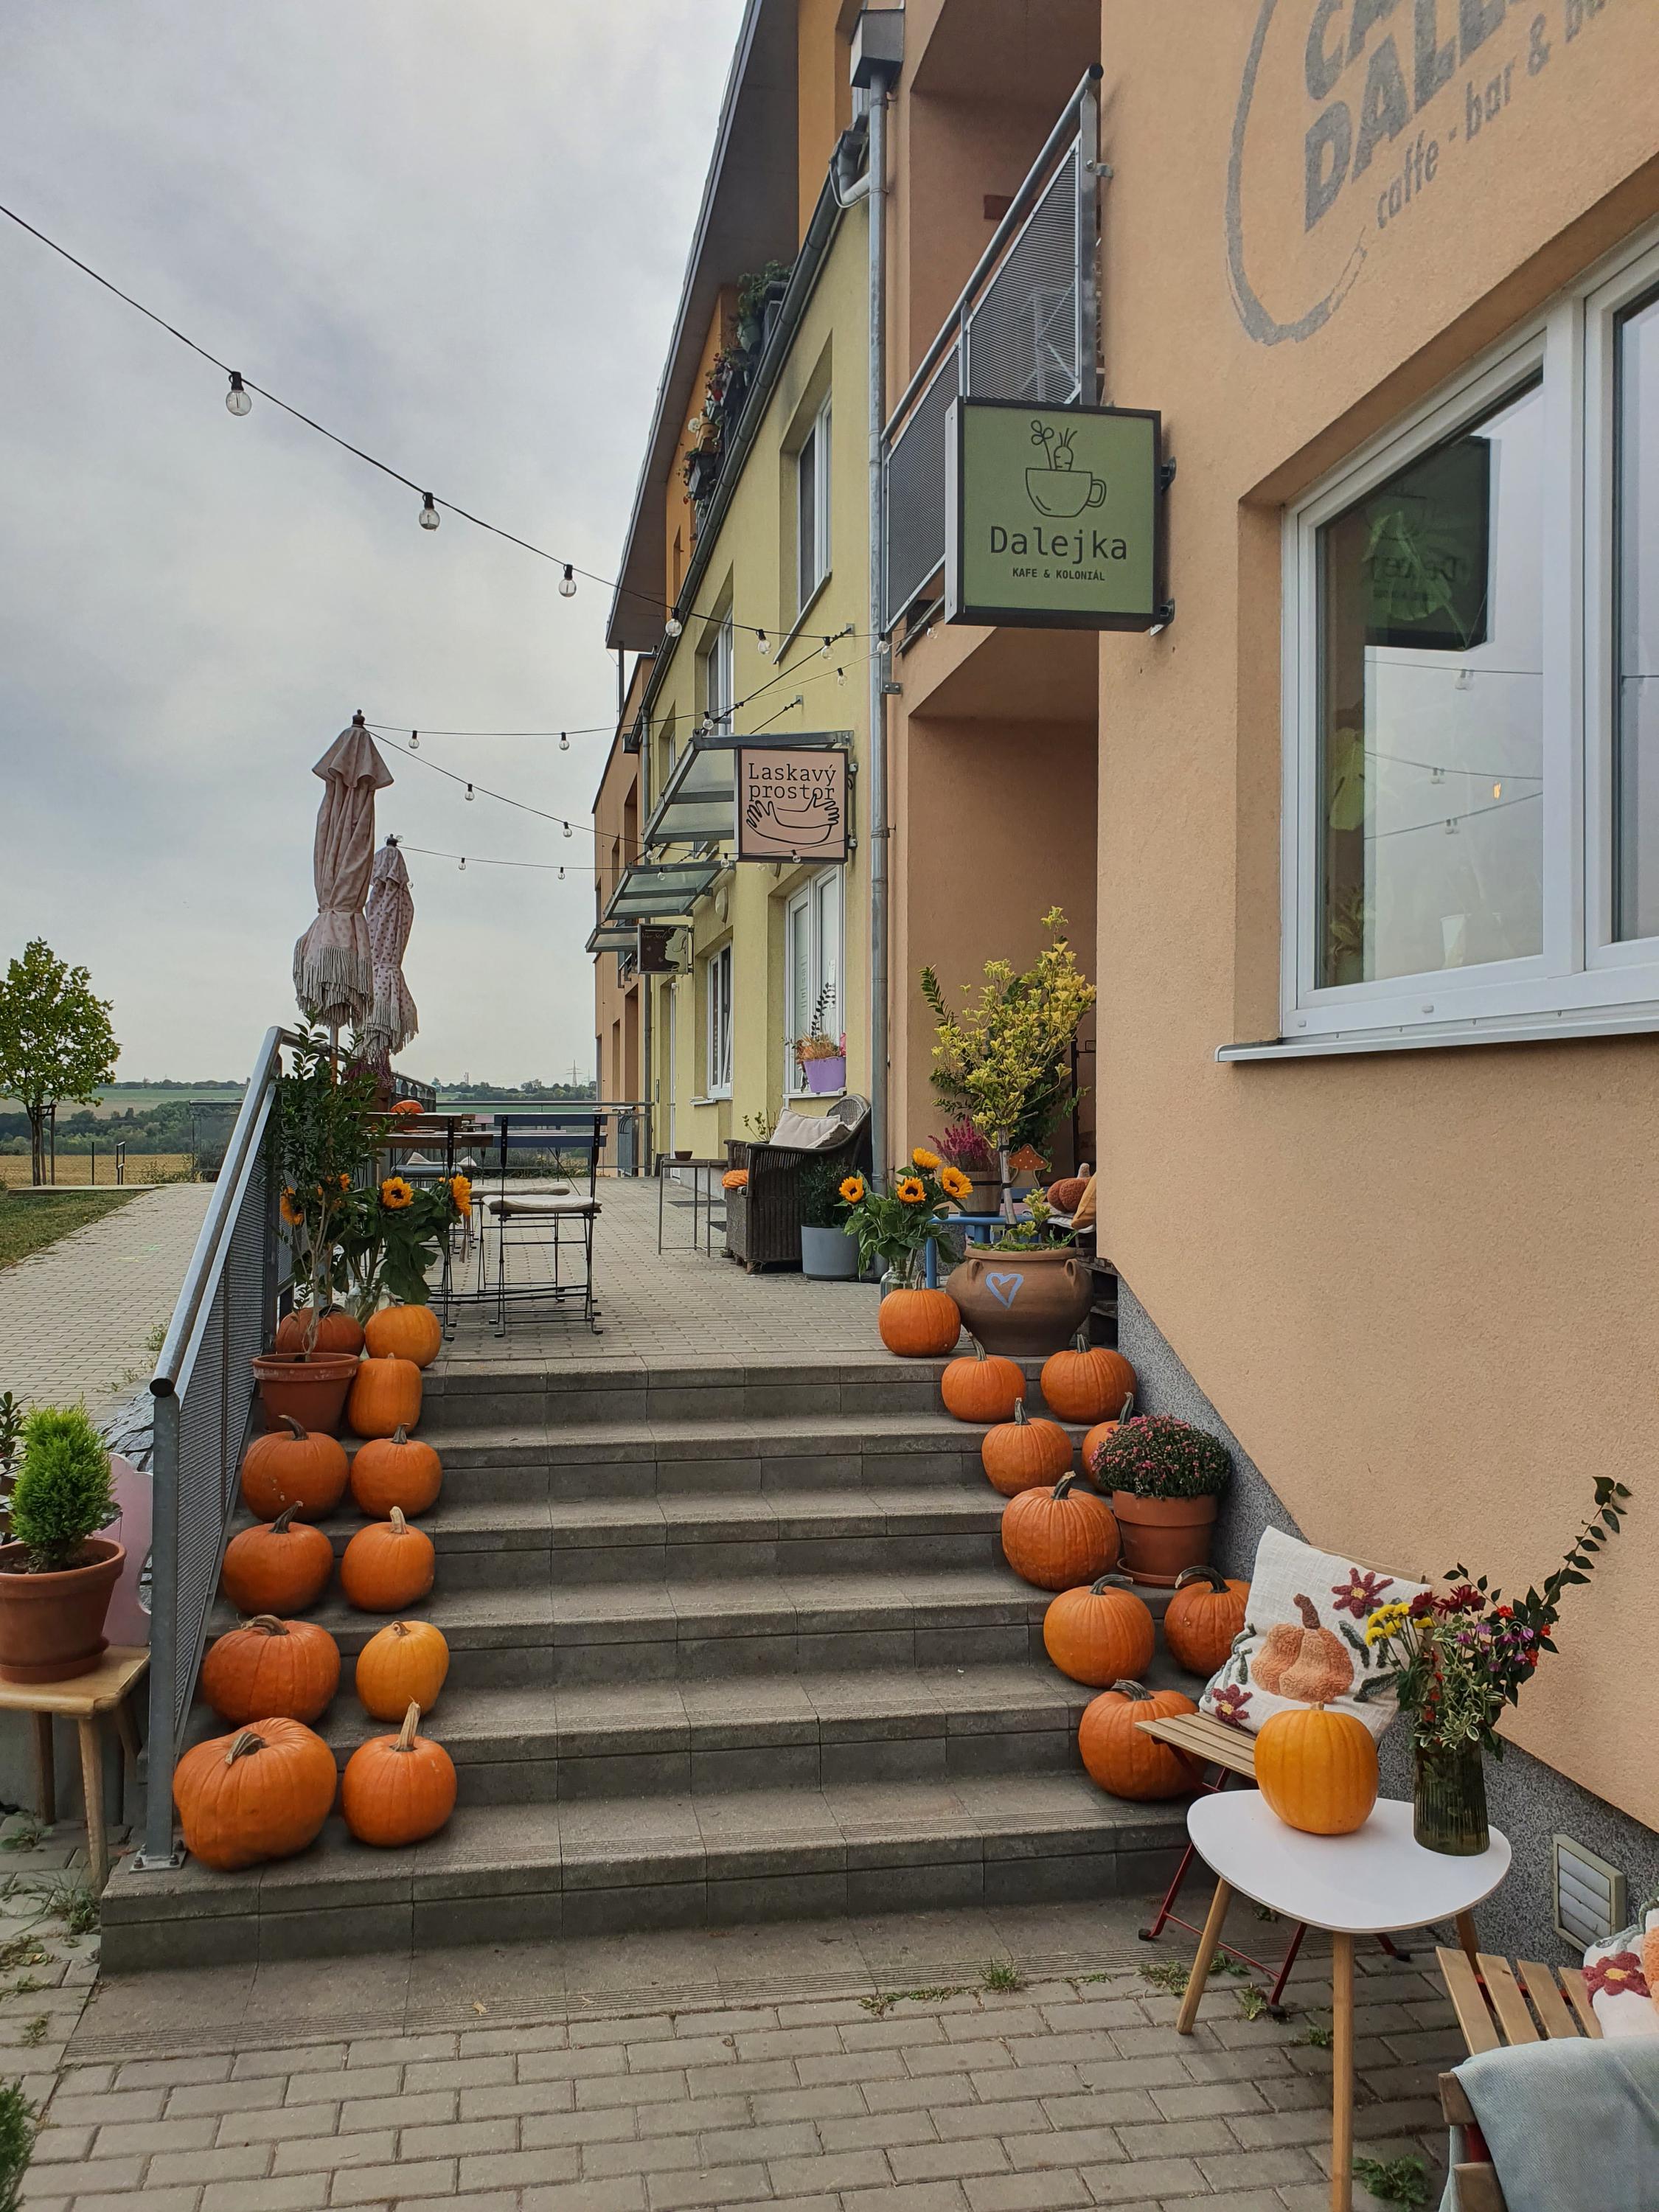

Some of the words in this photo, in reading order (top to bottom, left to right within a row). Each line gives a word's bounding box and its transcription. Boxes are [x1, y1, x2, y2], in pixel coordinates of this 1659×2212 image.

[1465, 55, 1517, 142] bar
[1527, 12, 1553, 77] &
[990, 525, 1127, 565] Dalejka
[1012, 567, 1038, 578] KAFE
[1043, 570, 1051, 579] &
[1056, 568, 1105, 581] KOLONIÁL
[748, 762, 837, 787] Laskavý
[748, 783, 835, 802] prostor
